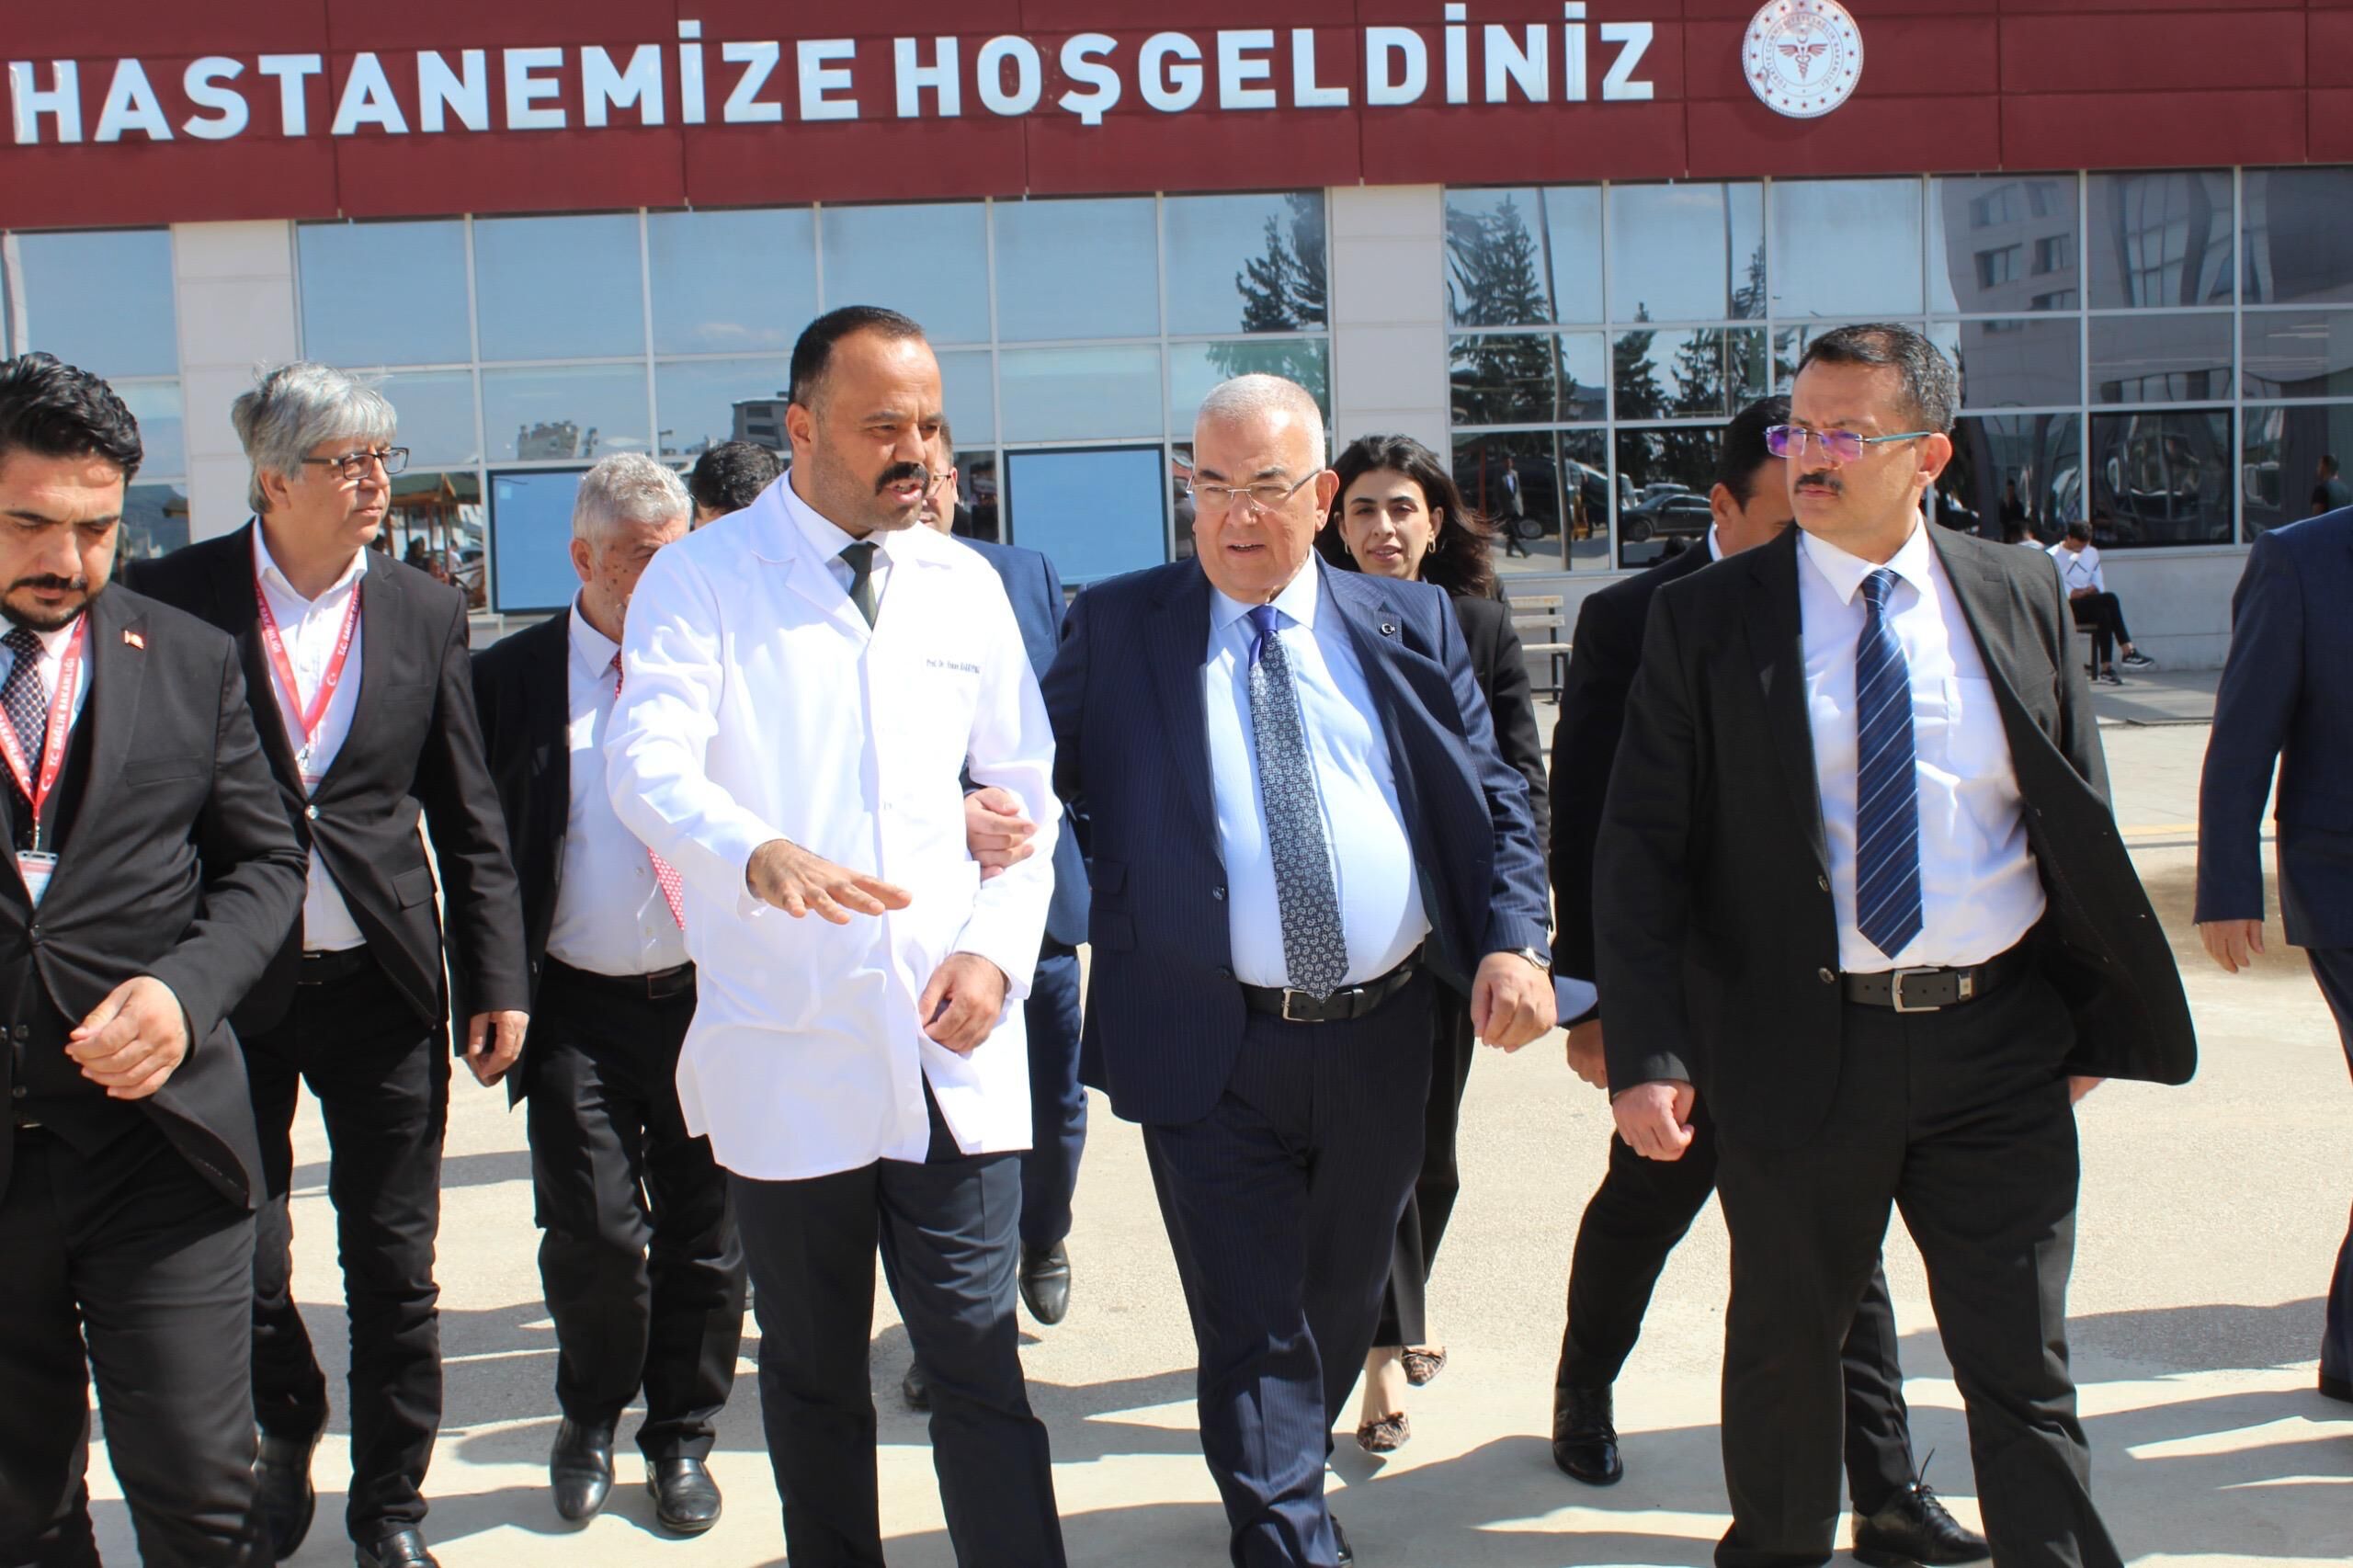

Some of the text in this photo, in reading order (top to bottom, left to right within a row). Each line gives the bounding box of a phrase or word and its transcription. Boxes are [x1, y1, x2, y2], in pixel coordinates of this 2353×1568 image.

[9, 2, 1654, 144] HASTANEMİZE HOŞGELDİNİZ
[58, 657, 75, 711] BAKANLIĞI
[51, 713, 67, 751] SAĞLIK
